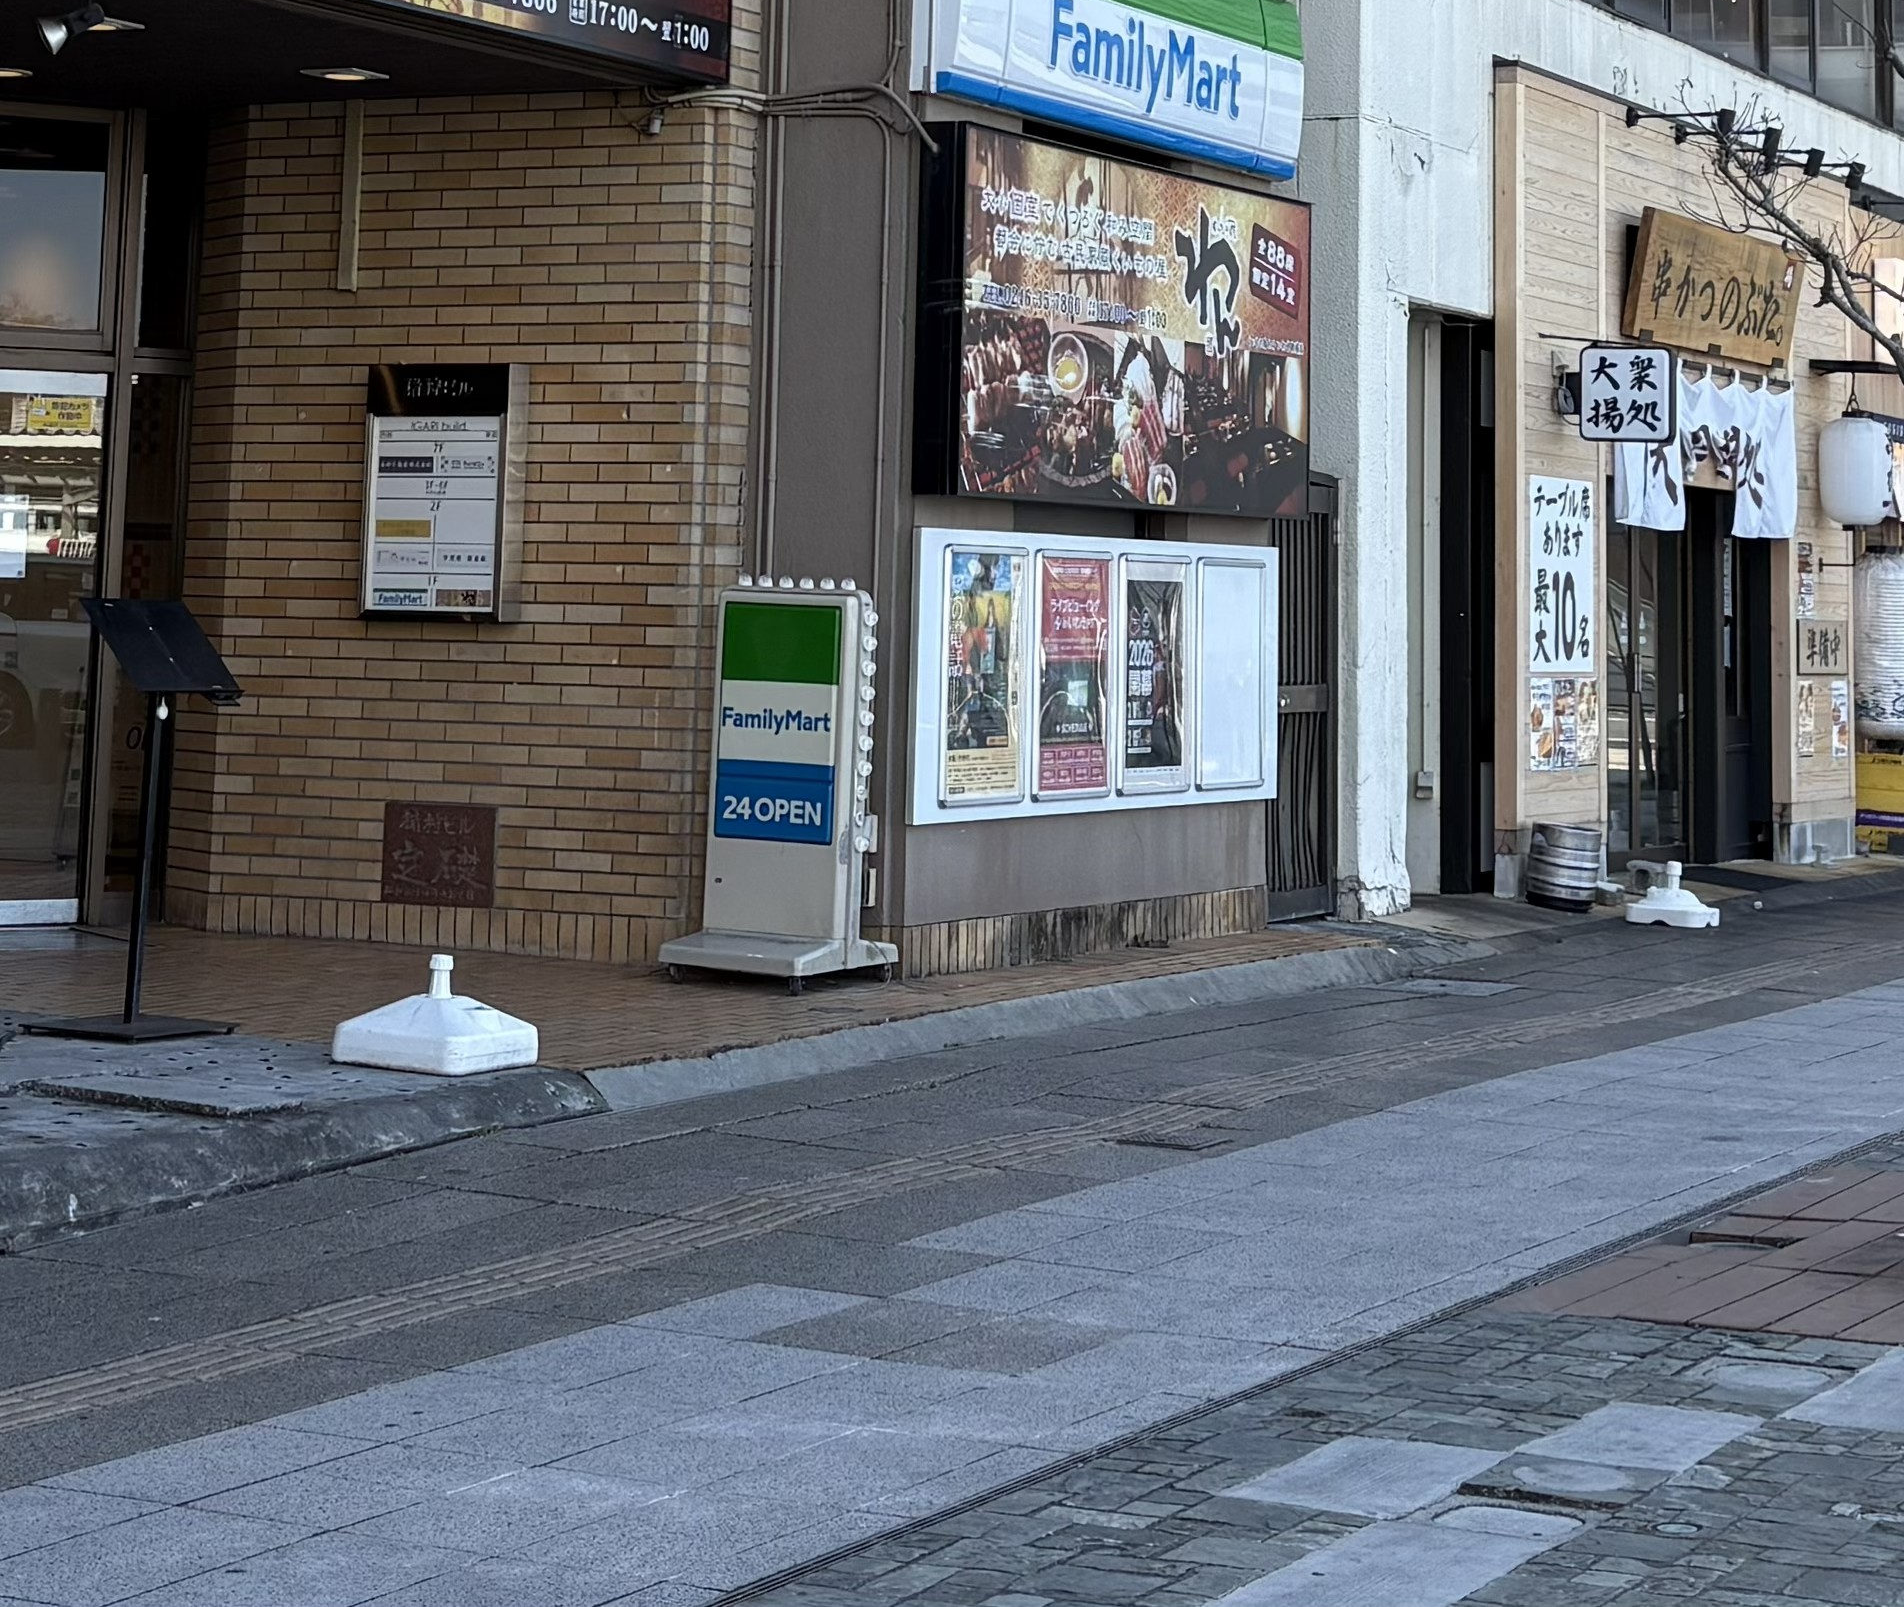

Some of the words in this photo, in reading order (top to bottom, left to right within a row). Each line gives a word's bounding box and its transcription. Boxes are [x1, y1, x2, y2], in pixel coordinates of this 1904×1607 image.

[1174, 203, 1242, 359] わん
[1590, 354, 1658, 393] 大衆
[1585, 399, 1662, 434] 揚処
[1533, 482, 1591, 524] テーブル席
[1542, 520, 1584, 557] あります
[378, 592, 424, 605] FamilyMart
[1128, 639, 1154, 666] 2026
[1806, 627, 1841, 668] 準備中
[722, 706, 831, 735] FamilyMart
